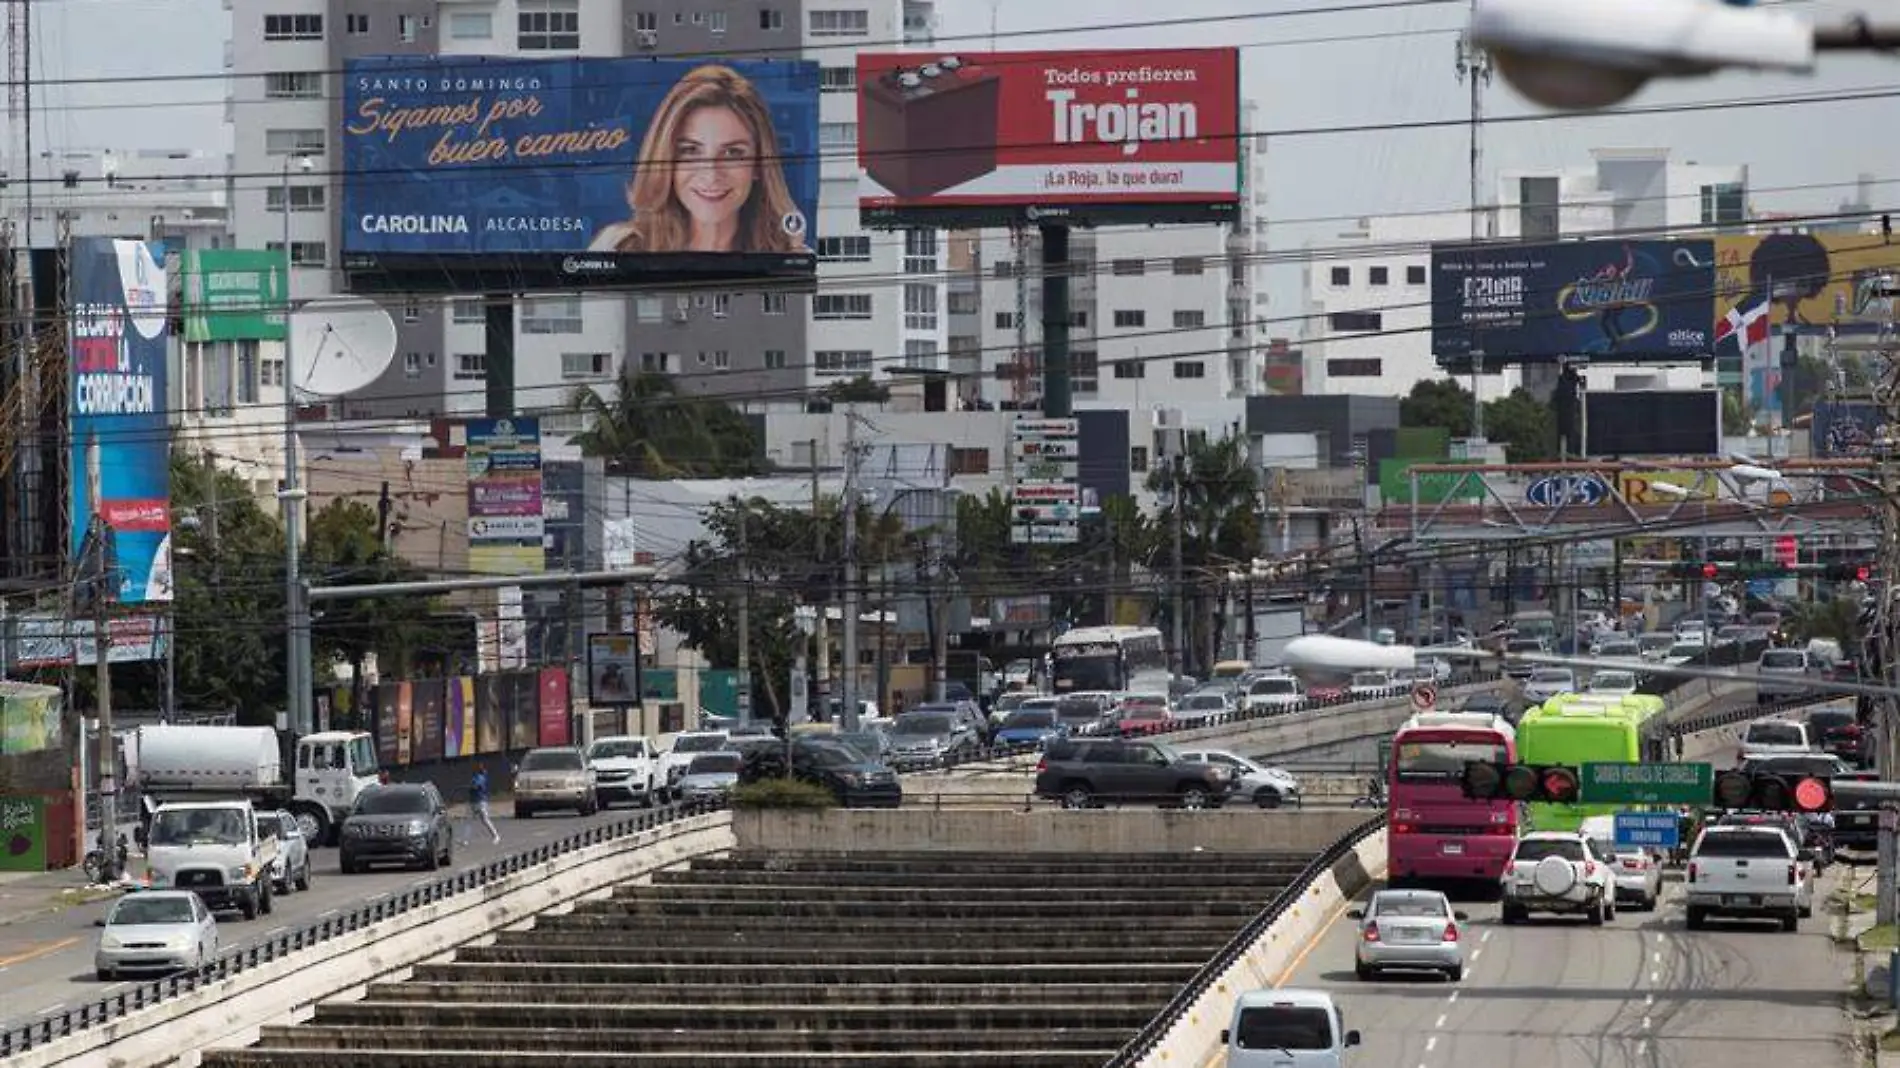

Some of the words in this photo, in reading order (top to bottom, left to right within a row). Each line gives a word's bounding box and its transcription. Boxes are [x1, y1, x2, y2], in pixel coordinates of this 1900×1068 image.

[360, 78, 428, 92] SANTO
[441, 78, 542, 92] DOMINGO
[1044, 69, 1101, 84] Todos
[1106, 67, 1198, 86] prefieren
[348, 96, 482, 143] Sigamos
[477, 95, 544, 139] por
[1045, 88, 1198, 155] Trojan
[428, 130, 510, 165] buen
[515, 121, 631, 157] camino
[1107, 170, 1120, 185] la
[1123, 172, 1147, 188] que
[1150, 169, 1184, 185] dura!
[361, 214, 470, 234] CAROLINA
[486, 216, 585, 232] ALCALDESA
